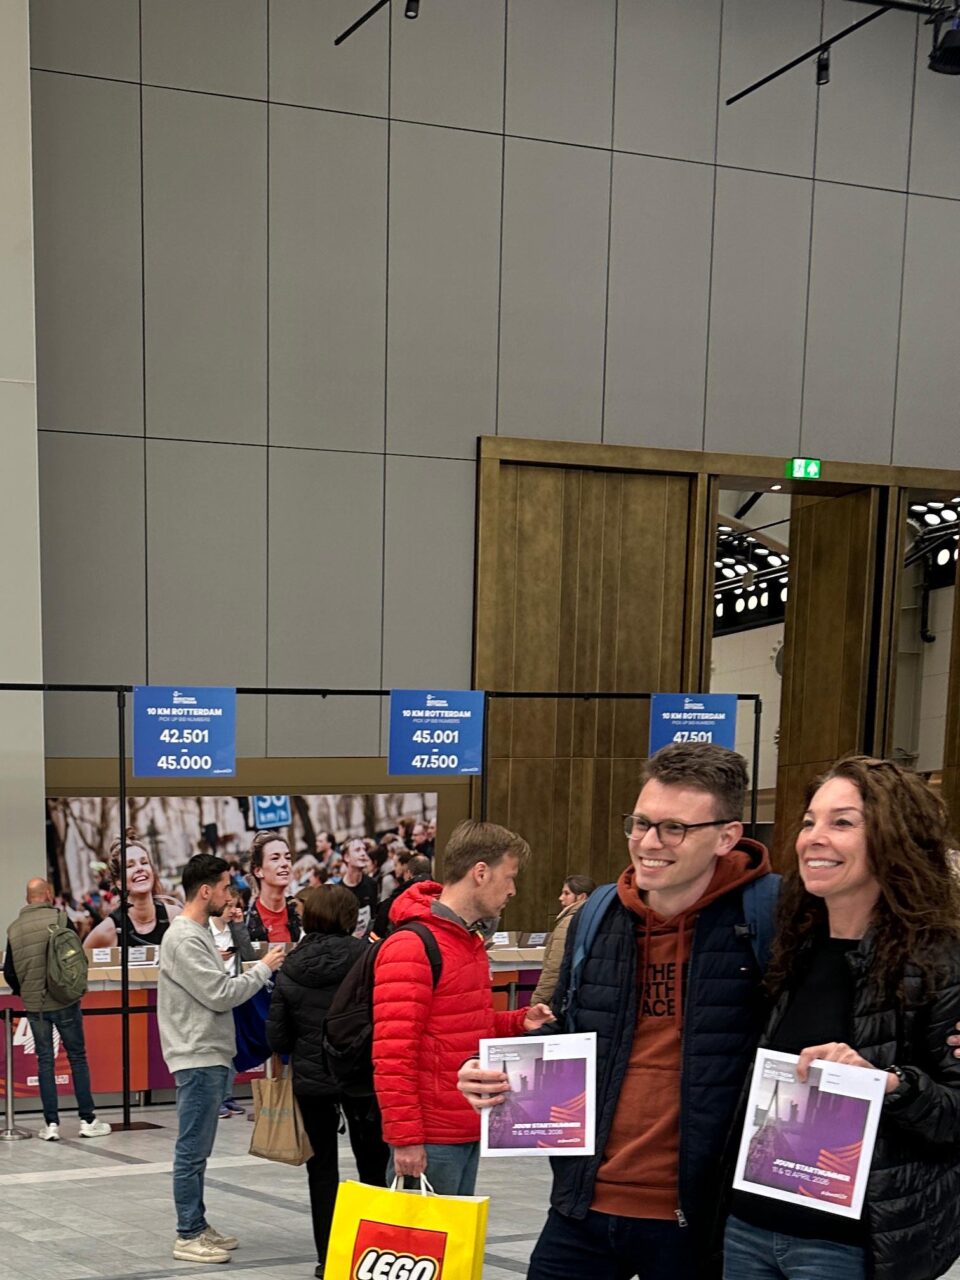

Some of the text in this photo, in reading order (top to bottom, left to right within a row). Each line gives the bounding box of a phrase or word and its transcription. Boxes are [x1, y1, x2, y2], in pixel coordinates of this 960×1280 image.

[171, 708, 222, 716] ROTTERDAM
[160, 729, 209, 743] 42.501
[412, 730, 459, 743] 45.001
[673, 731, 712, 744] 47.501
[157, 756, 212, 769] 45.000
[411, 755, 458, 768] 47.500
[260, 809, 288, 822] km/h
[643, 981, 675, 999] RTH
[642, 999, 675, 1016] ACE
